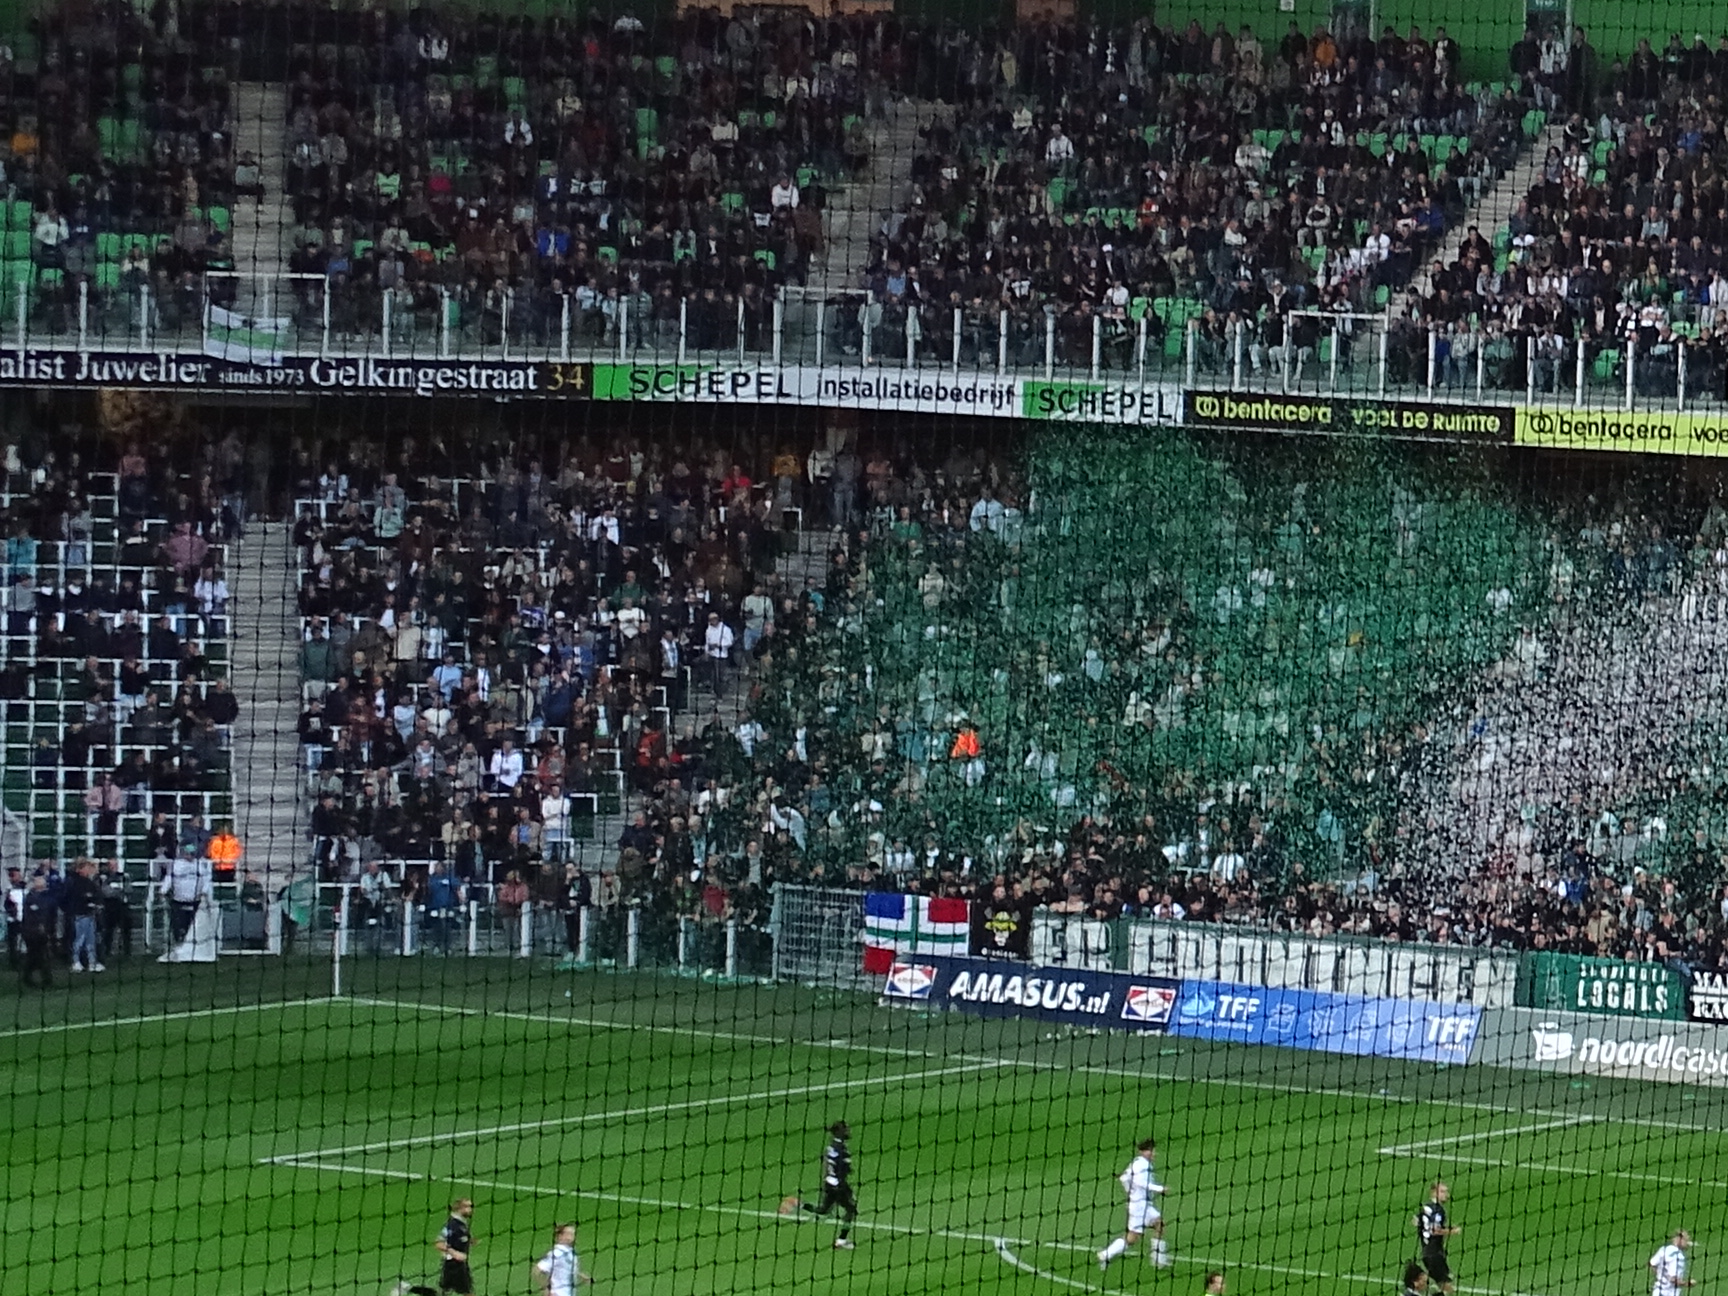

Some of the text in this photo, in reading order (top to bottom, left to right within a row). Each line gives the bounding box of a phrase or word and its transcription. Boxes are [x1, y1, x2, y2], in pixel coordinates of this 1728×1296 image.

[75, 352, 212, 385] Juwelier
[310, 358, 538, 394] Gelkingestraat
[546, 363, 586, 392] 34
[628, 368, 1016, 411] SCHEPEL installatiebedrijf
[1037, 387, 1174, 421] SCHEPEL
[1223, 395, 1332, 425] bentacera
[1559, 417, 1673, 442] bentacera
[950, 970, 1110, 1014] AMASUS.nl
[1218, 995, 1260, 1019] TFF
[1577, 979, 1668, 1013] LOCALS
[1428, 1015, 1476, 1042] TFF
